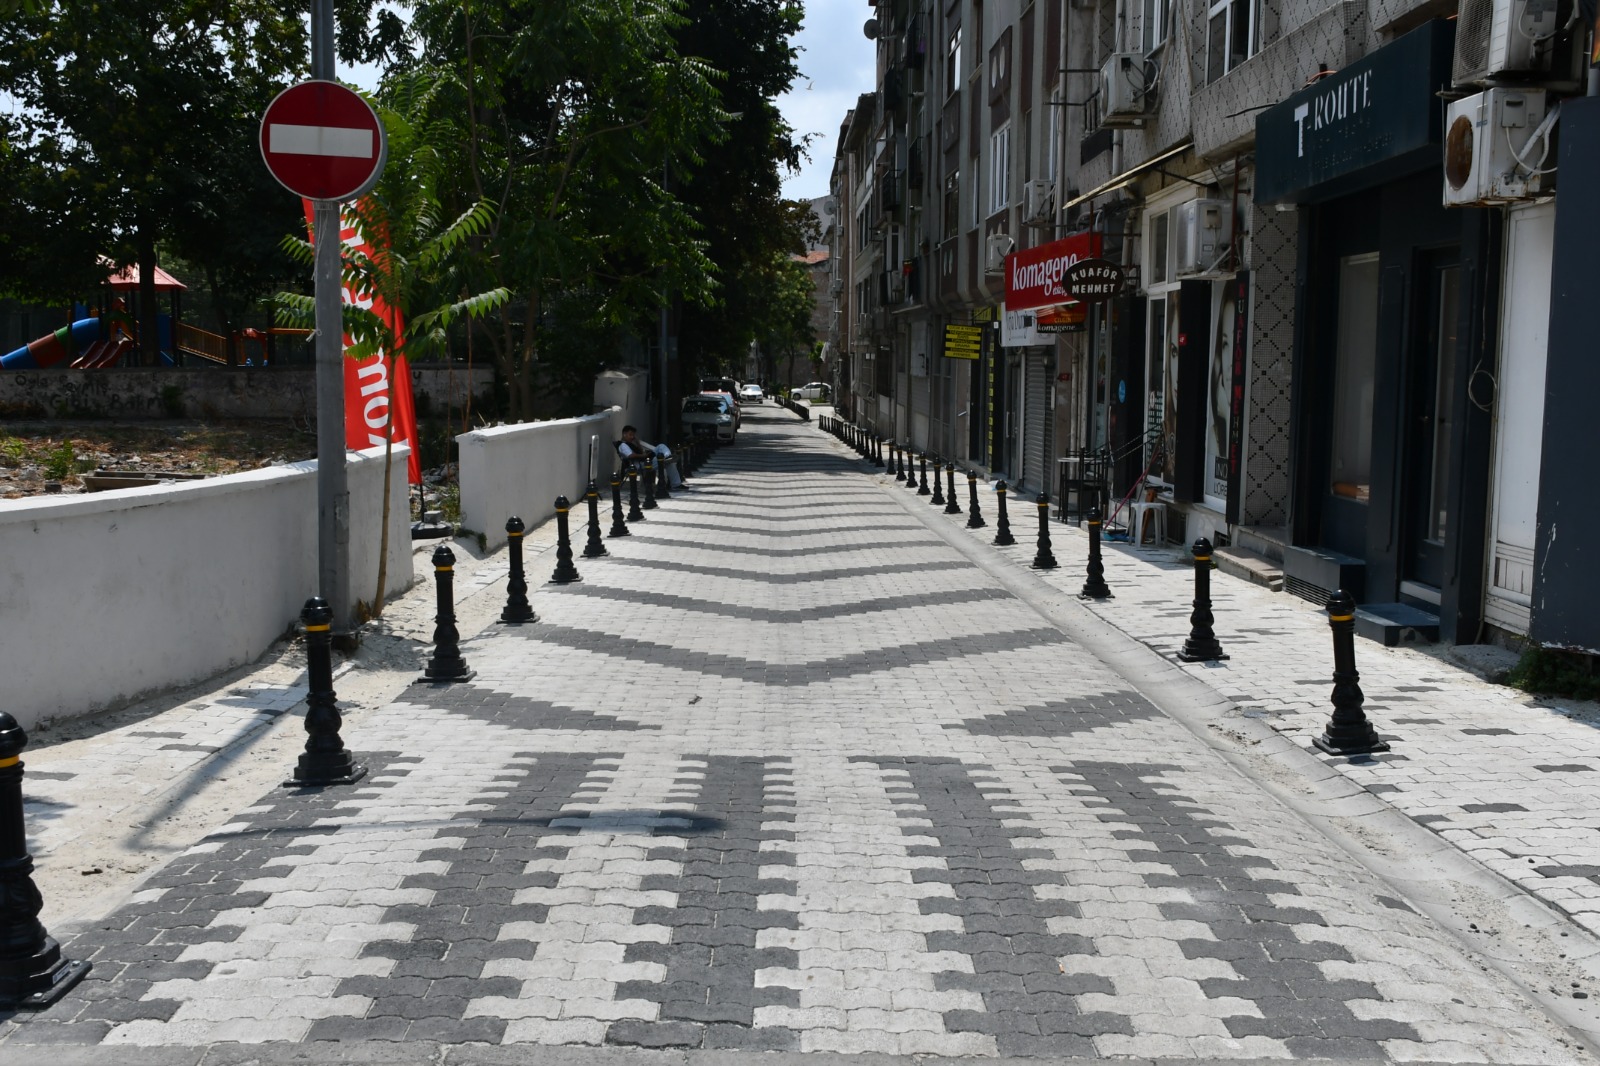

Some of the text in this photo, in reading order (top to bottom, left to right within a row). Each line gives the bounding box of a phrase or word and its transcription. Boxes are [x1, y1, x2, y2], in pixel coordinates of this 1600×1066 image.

[1071, 266, 1118, 282] KUAFÖR
[1071, 283, 1115, 294] MEHMET
[1037, 323, 1076, 333] komagene
